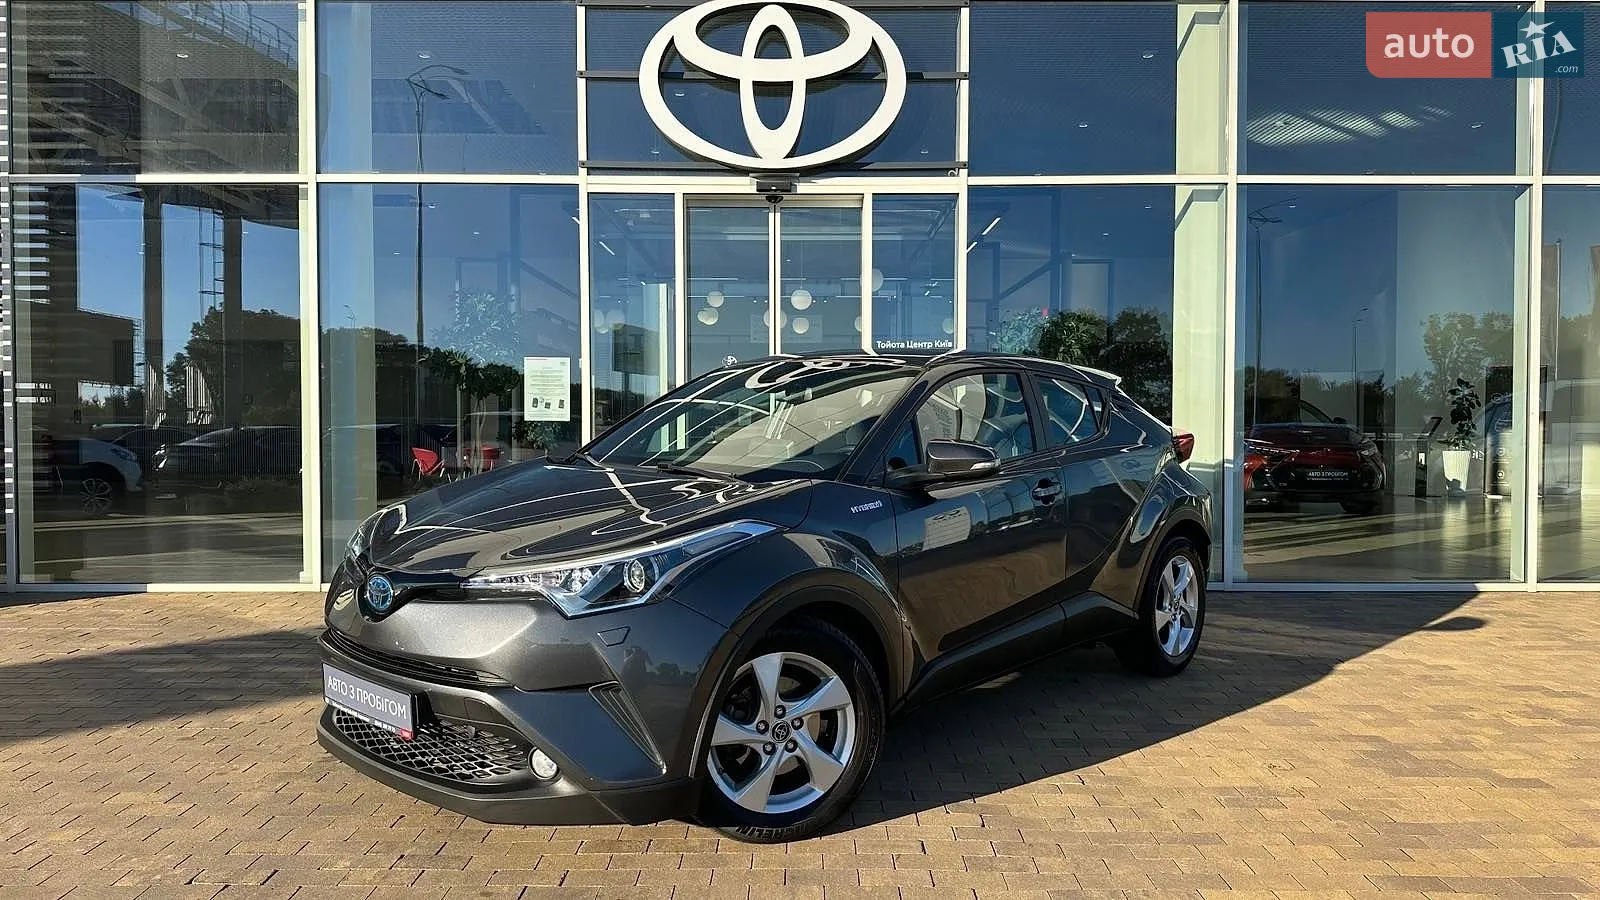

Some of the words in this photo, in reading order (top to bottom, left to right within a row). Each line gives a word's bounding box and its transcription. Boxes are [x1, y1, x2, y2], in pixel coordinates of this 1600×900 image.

[876, 340, 905, 349] Тойота
[907, 341, 933, 349] Центр
[935, 340, 953, 348] Київ
[327, 675, 348, 696] АВТО
[349, 685, 355, 699] З
[357, 688, 407, 719] ПРОБІГОМ
